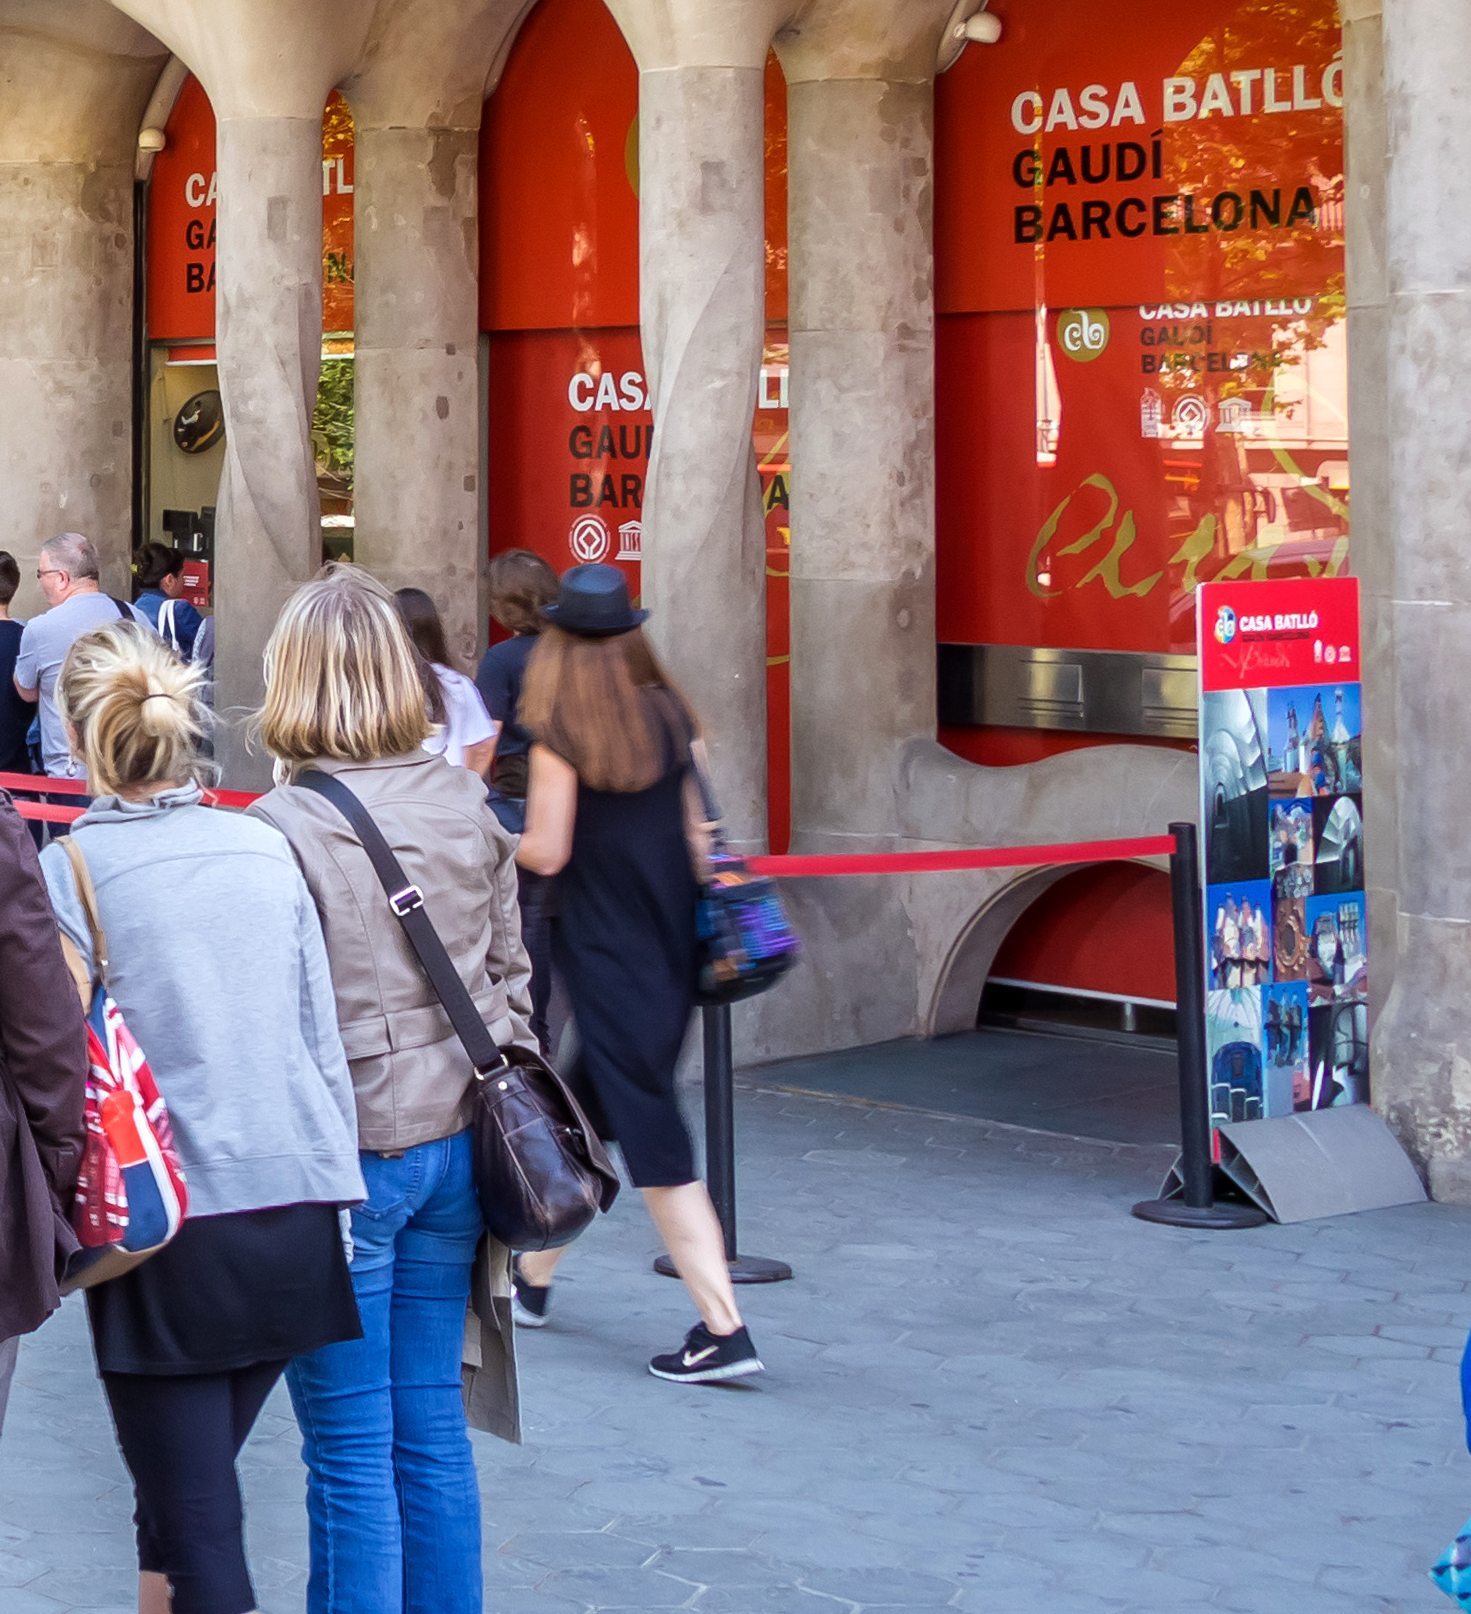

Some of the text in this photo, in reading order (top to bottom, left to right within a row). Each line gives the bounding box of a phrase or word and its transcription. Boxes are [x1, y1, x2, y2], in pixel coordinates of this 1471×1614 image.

[1011, 81, 1146, 135] CASA
[1012, 128, 1164, 189] GAUDÍ
[1013, 185, 1320, 244] BARCELONA
[568, 423, 655, 460] GAU
[1239, 610, 1319, 633] CASA BATLLÓ
